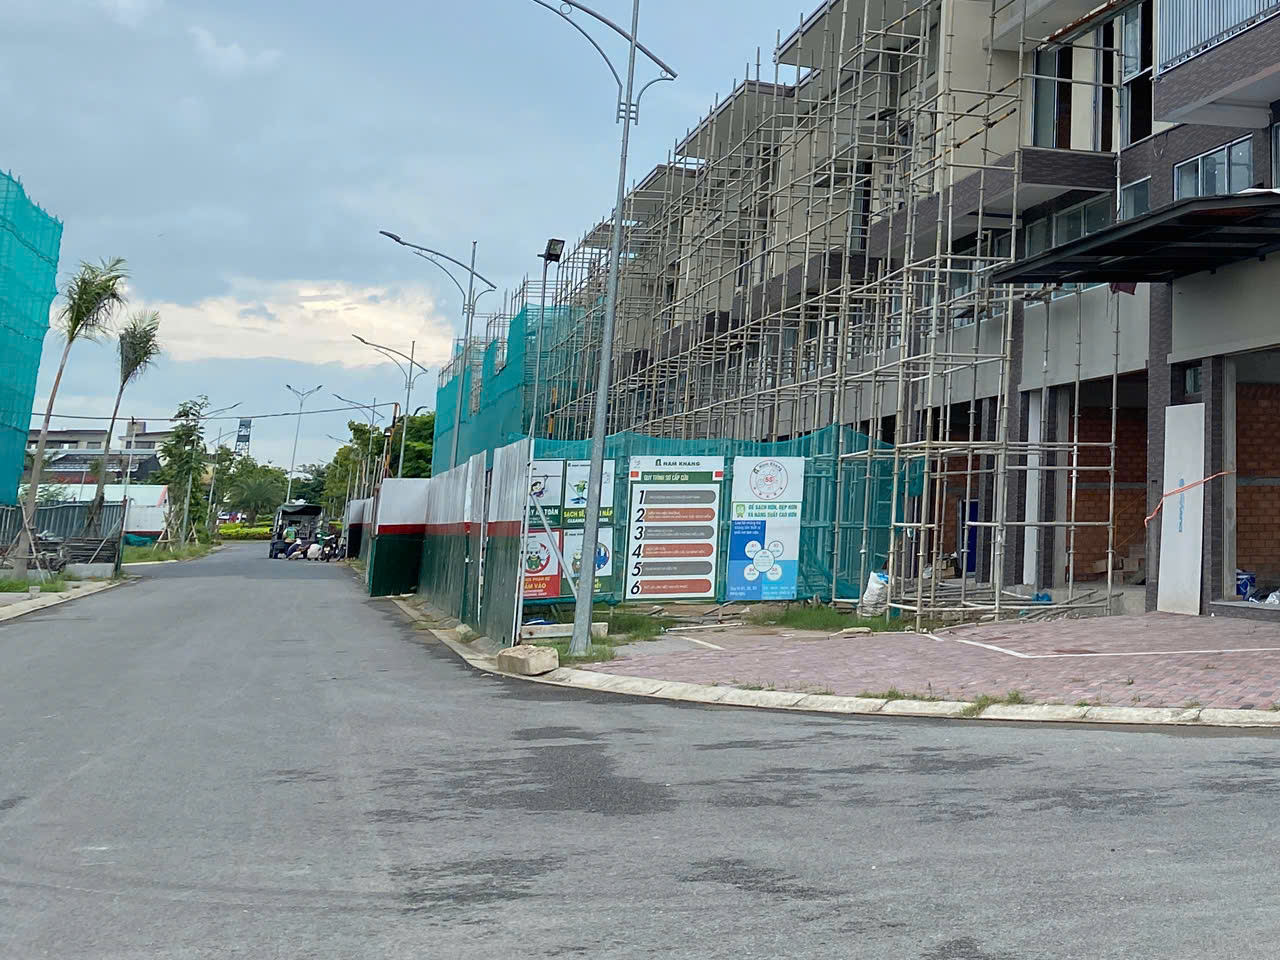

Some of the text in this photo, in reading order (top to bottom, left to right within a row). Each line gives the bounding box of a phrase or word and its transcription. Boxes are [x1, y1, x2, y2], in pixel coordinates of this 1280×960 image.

[639, 490, 644, 504] 1
[635, 508, 645, 522] 2
[634, 526, 644, 540] 3
[632, 543, 642, 558] 4
[631, 562, 641, 576] 5
[630, 580, 640, 594] 6
